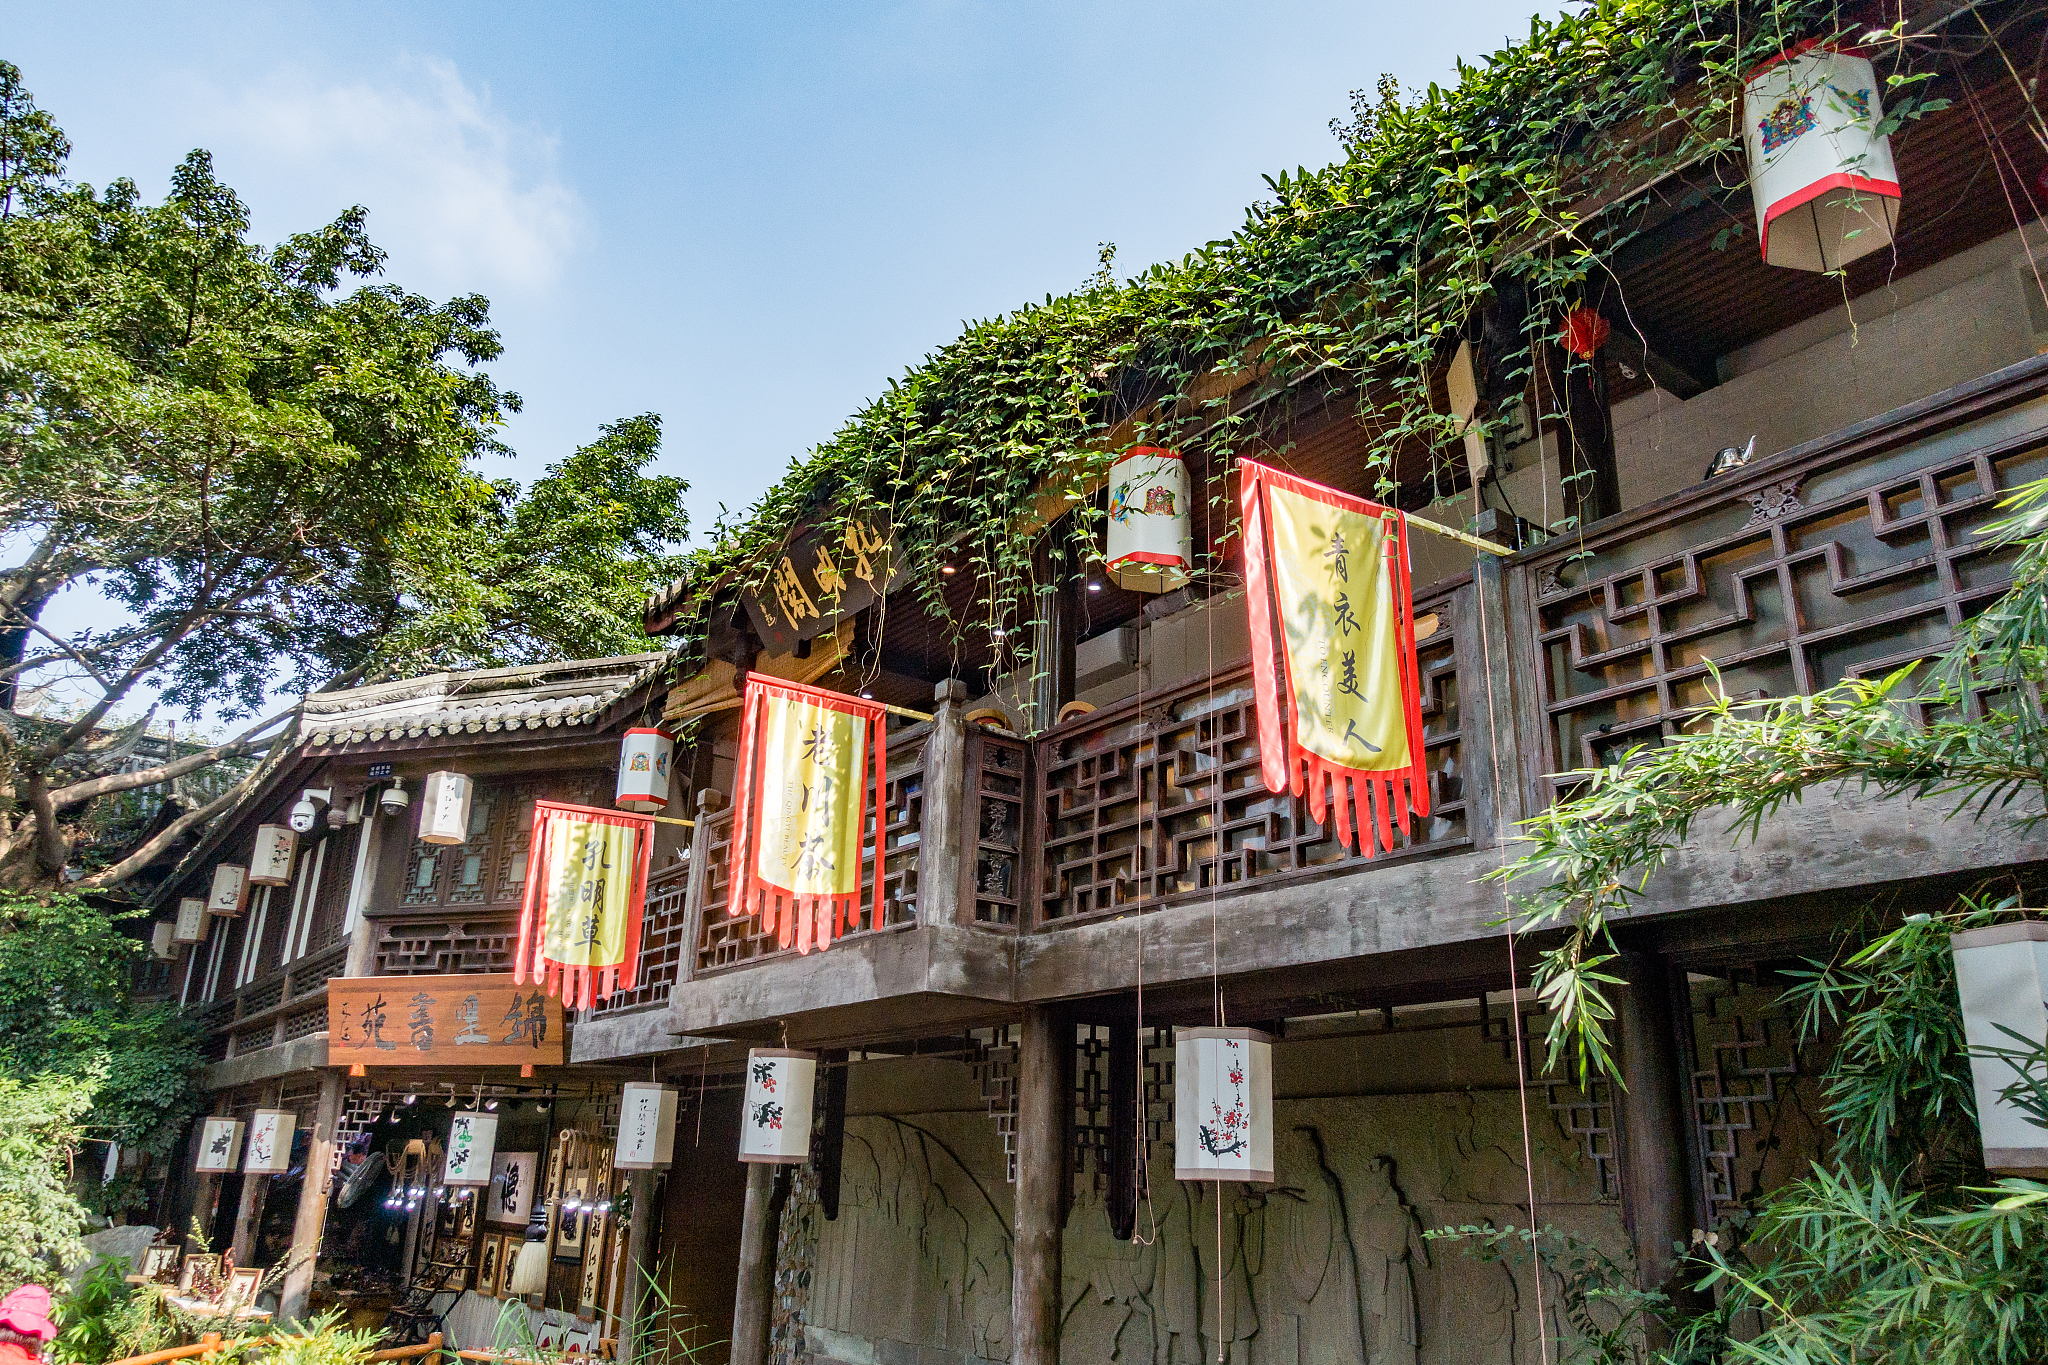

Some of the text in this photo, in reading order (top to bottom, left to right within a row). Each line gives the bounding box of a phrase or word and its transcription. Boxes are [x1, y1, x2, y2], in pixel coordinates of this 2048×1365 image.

[1320, 658, 1334, 734] ENCOUNTER
[1324, 532, 1382, 753] 青衣美人
[781, 834, 790, 868] BEAUTY
[791, 722, 835, 882] 老川茶
[574, 839, 612, 955] 孔明草
